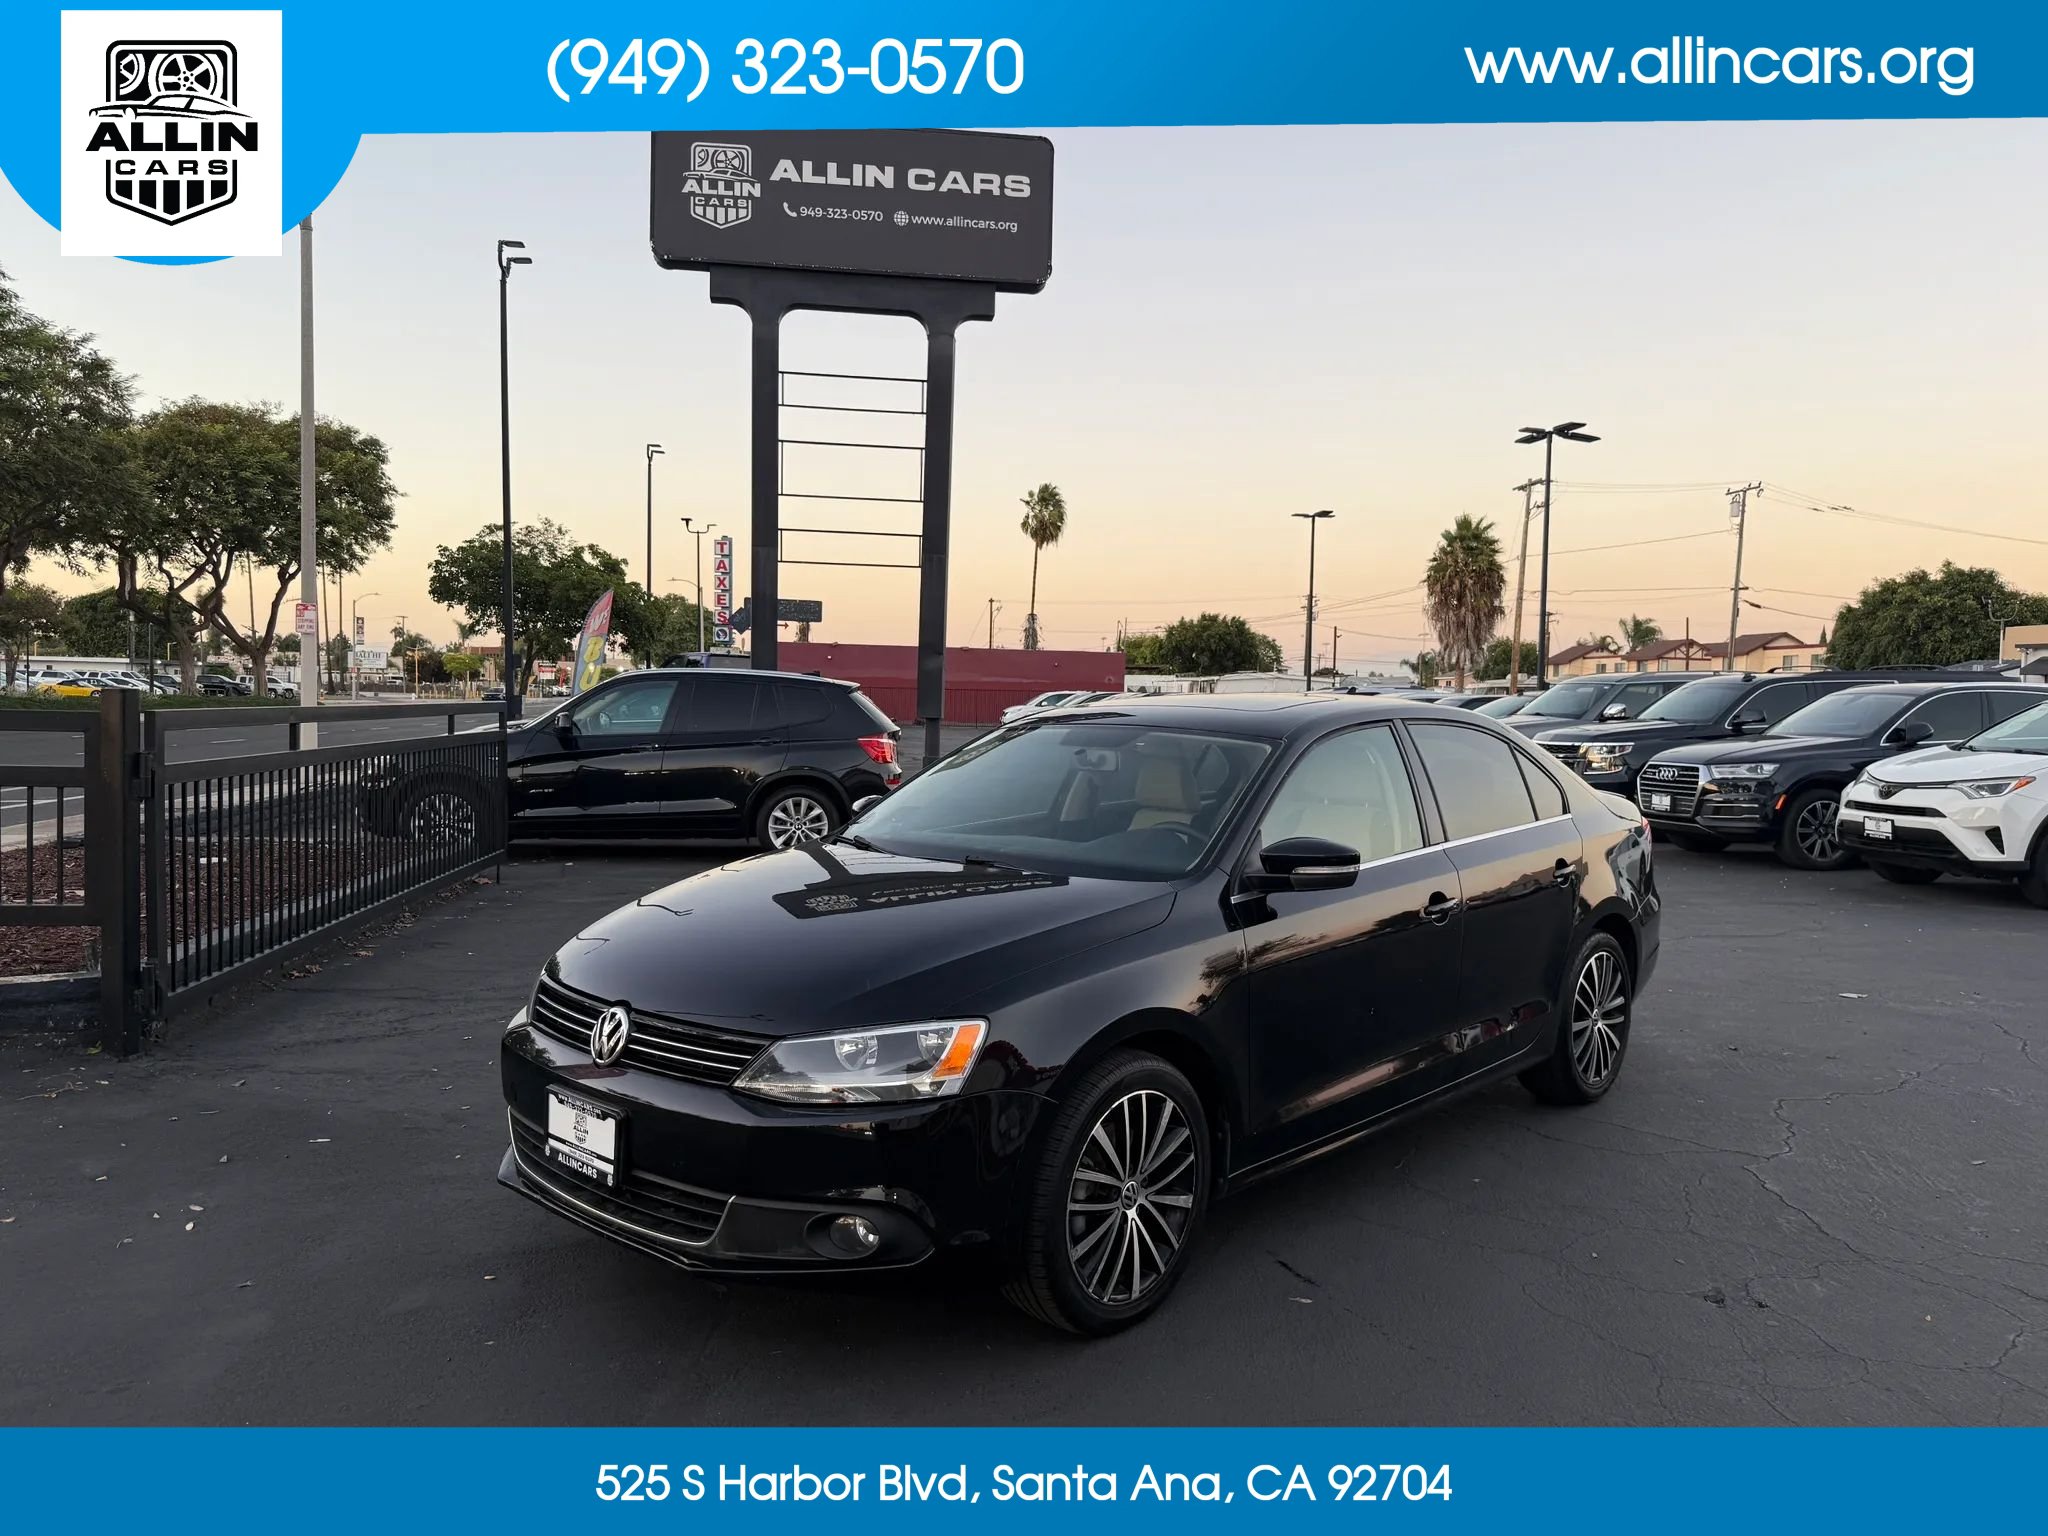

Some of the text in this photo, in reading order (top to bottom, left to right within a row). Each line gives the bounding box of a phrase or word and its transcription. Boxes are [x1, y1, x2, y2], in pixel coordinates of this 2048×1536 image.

[681, 178, 761, 198] ALLIN
[769, 158, 1031, 198] ALLIN CARS
[695, 196, 748, 207] CARS
[799, 206, 884, 222] 949-323-0570
[911, 214, 1018, 233] www.allincars.org
[715, 541, 728, 625] TAXES
[558, 1152, 598, 1179] ALLINCARS
